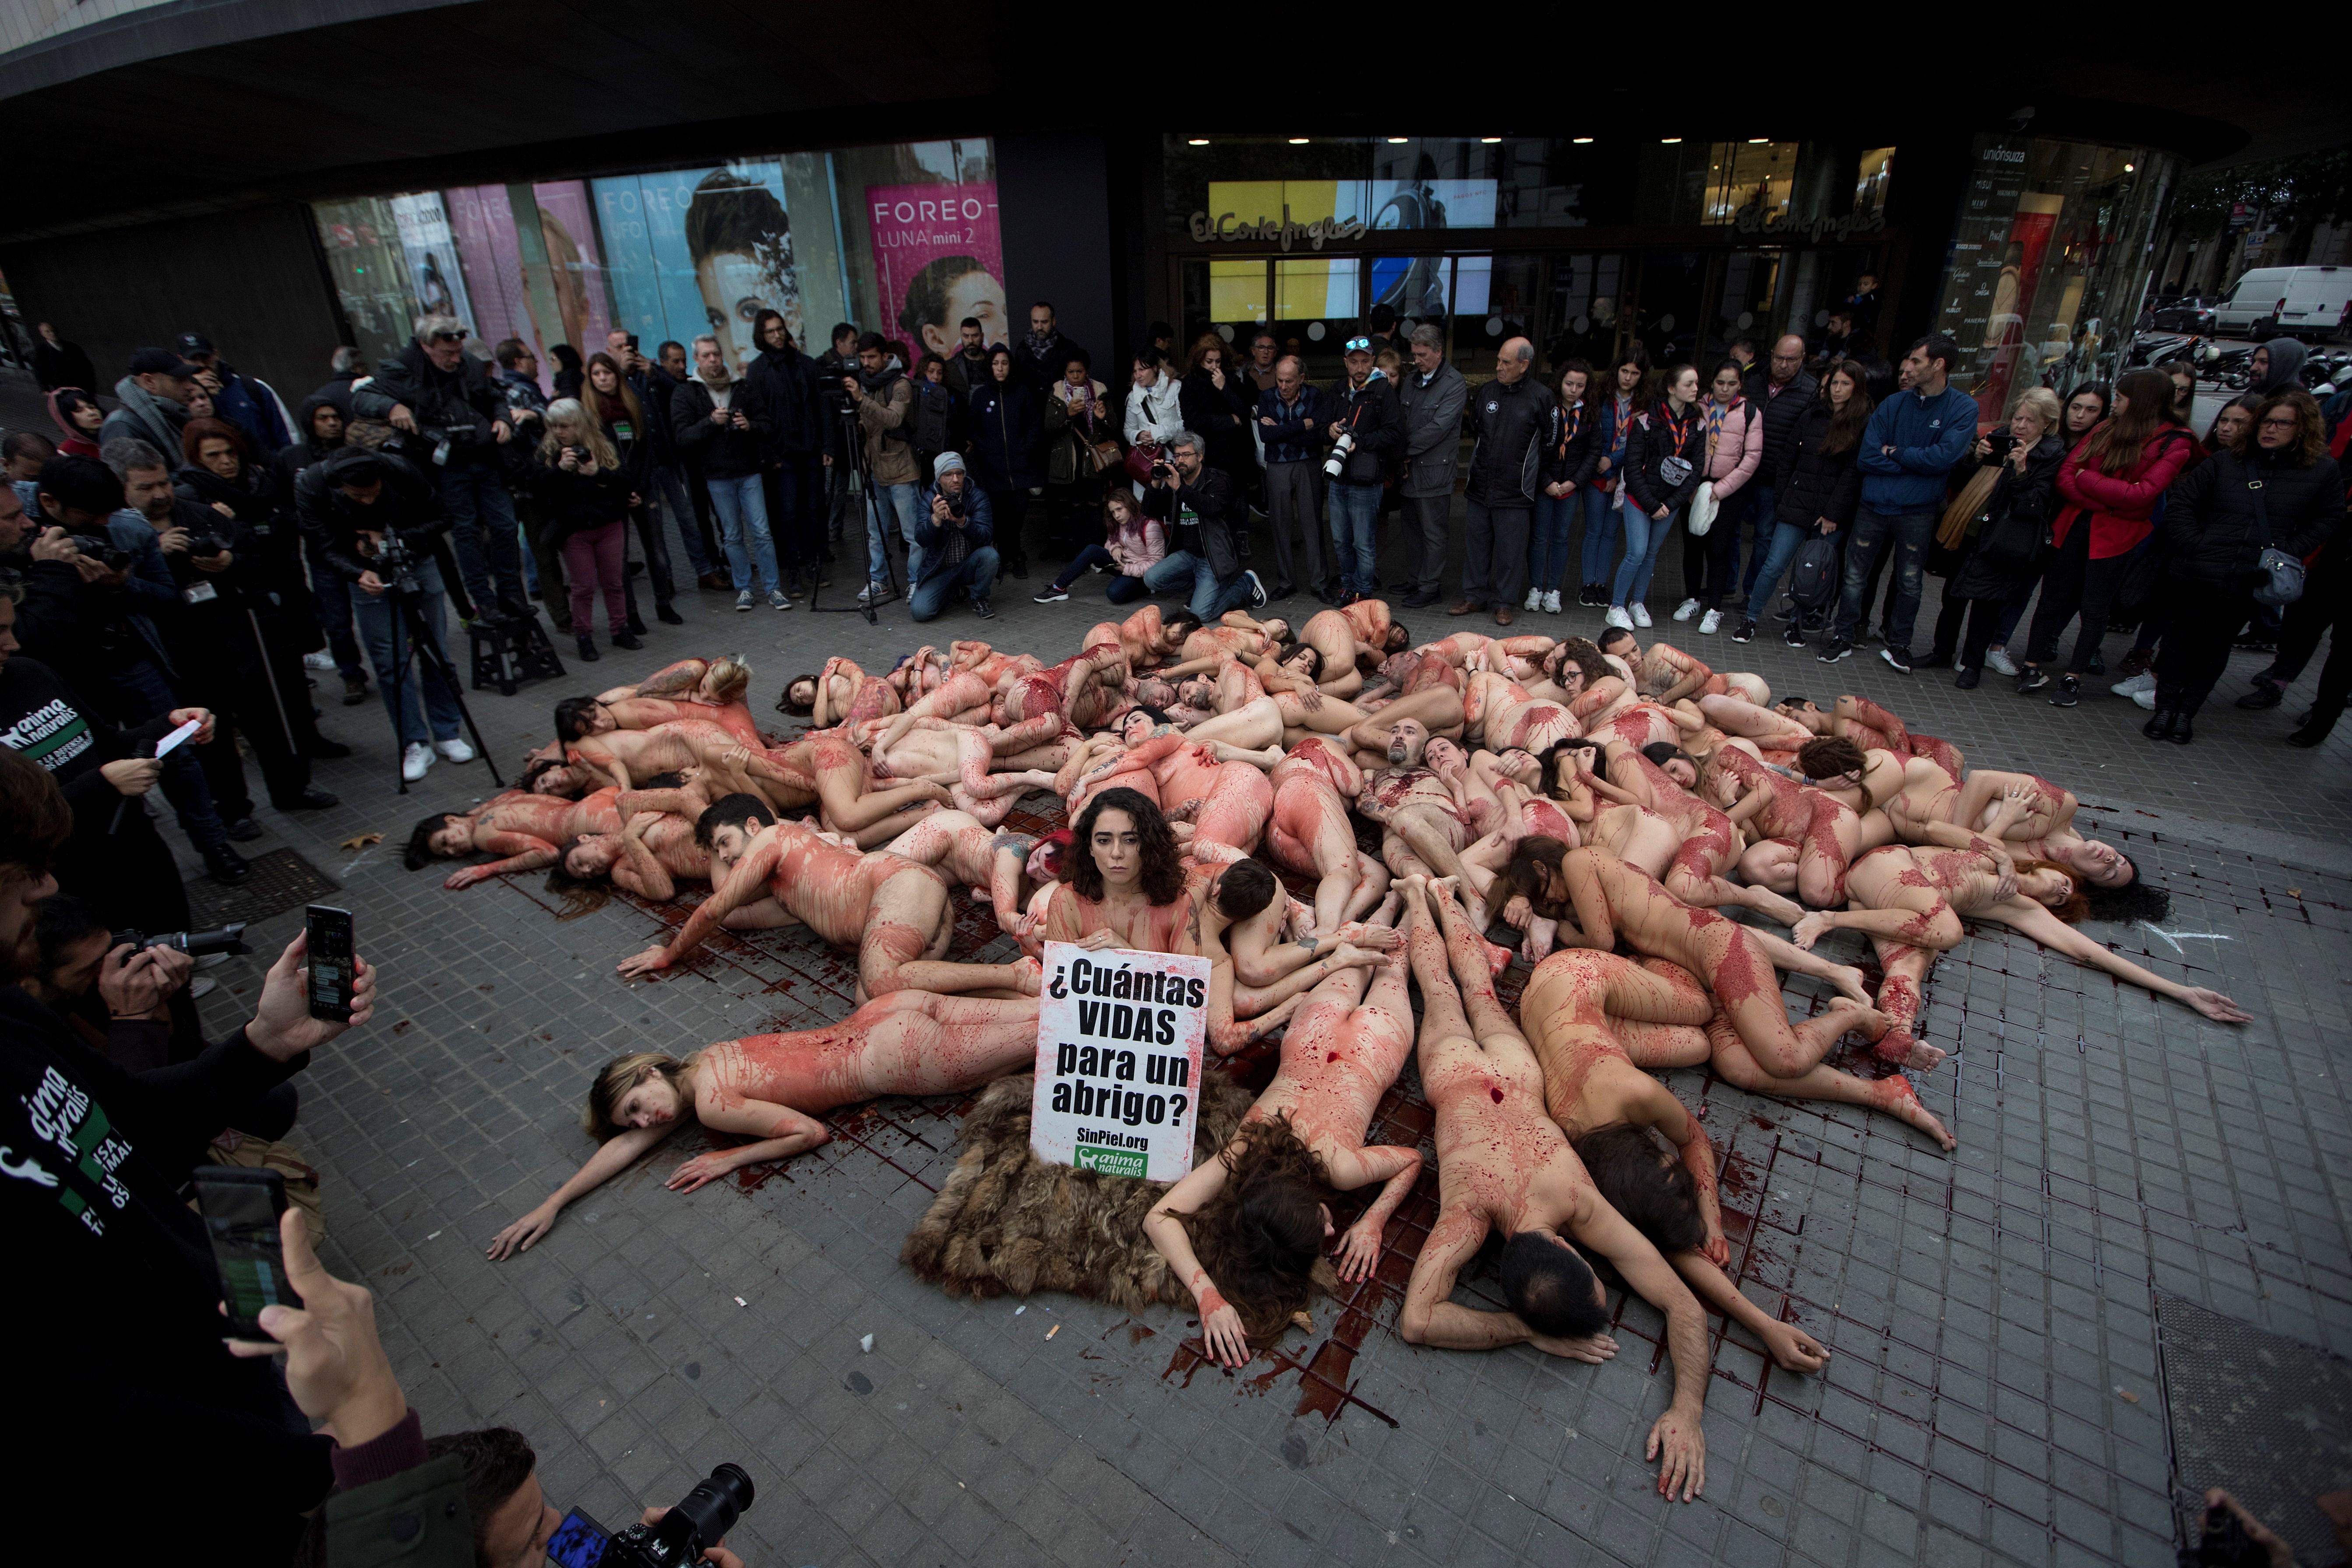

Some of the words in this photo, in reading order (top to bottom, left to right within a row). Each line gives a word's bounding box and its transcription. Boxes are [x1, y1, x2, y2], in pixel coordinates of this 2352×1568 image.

[874, 198, 982, 224] FOREO
[1189, 211, 1217, 242] El
[1217, 212, 1279, 242] Corte
[1280, 204, 1366, 252] Inglés
[877, 229, 928, 248] LUNA
[932, 230, 962, 245] mini
[965, 227, 974, 243] 2
[17, 698, 67, 733] anima
[27, 707, 78, 742] naturalis
[1050, 958, 1205, 1008] ¿Cuántas
[1079, 1000, 1176, 1045] VIDAS
[1056, 1042, 1135, 1082] para
[1146, 1054, 1189, 1088] un
[1052, 1079, 1188, 1127] abrigo?
[1077, 1127, 1149, 1152] SinPiel.org
[1096, 1152, 1143, 1167] anima
[1098, 1163, 1143, 1177] naturalis
